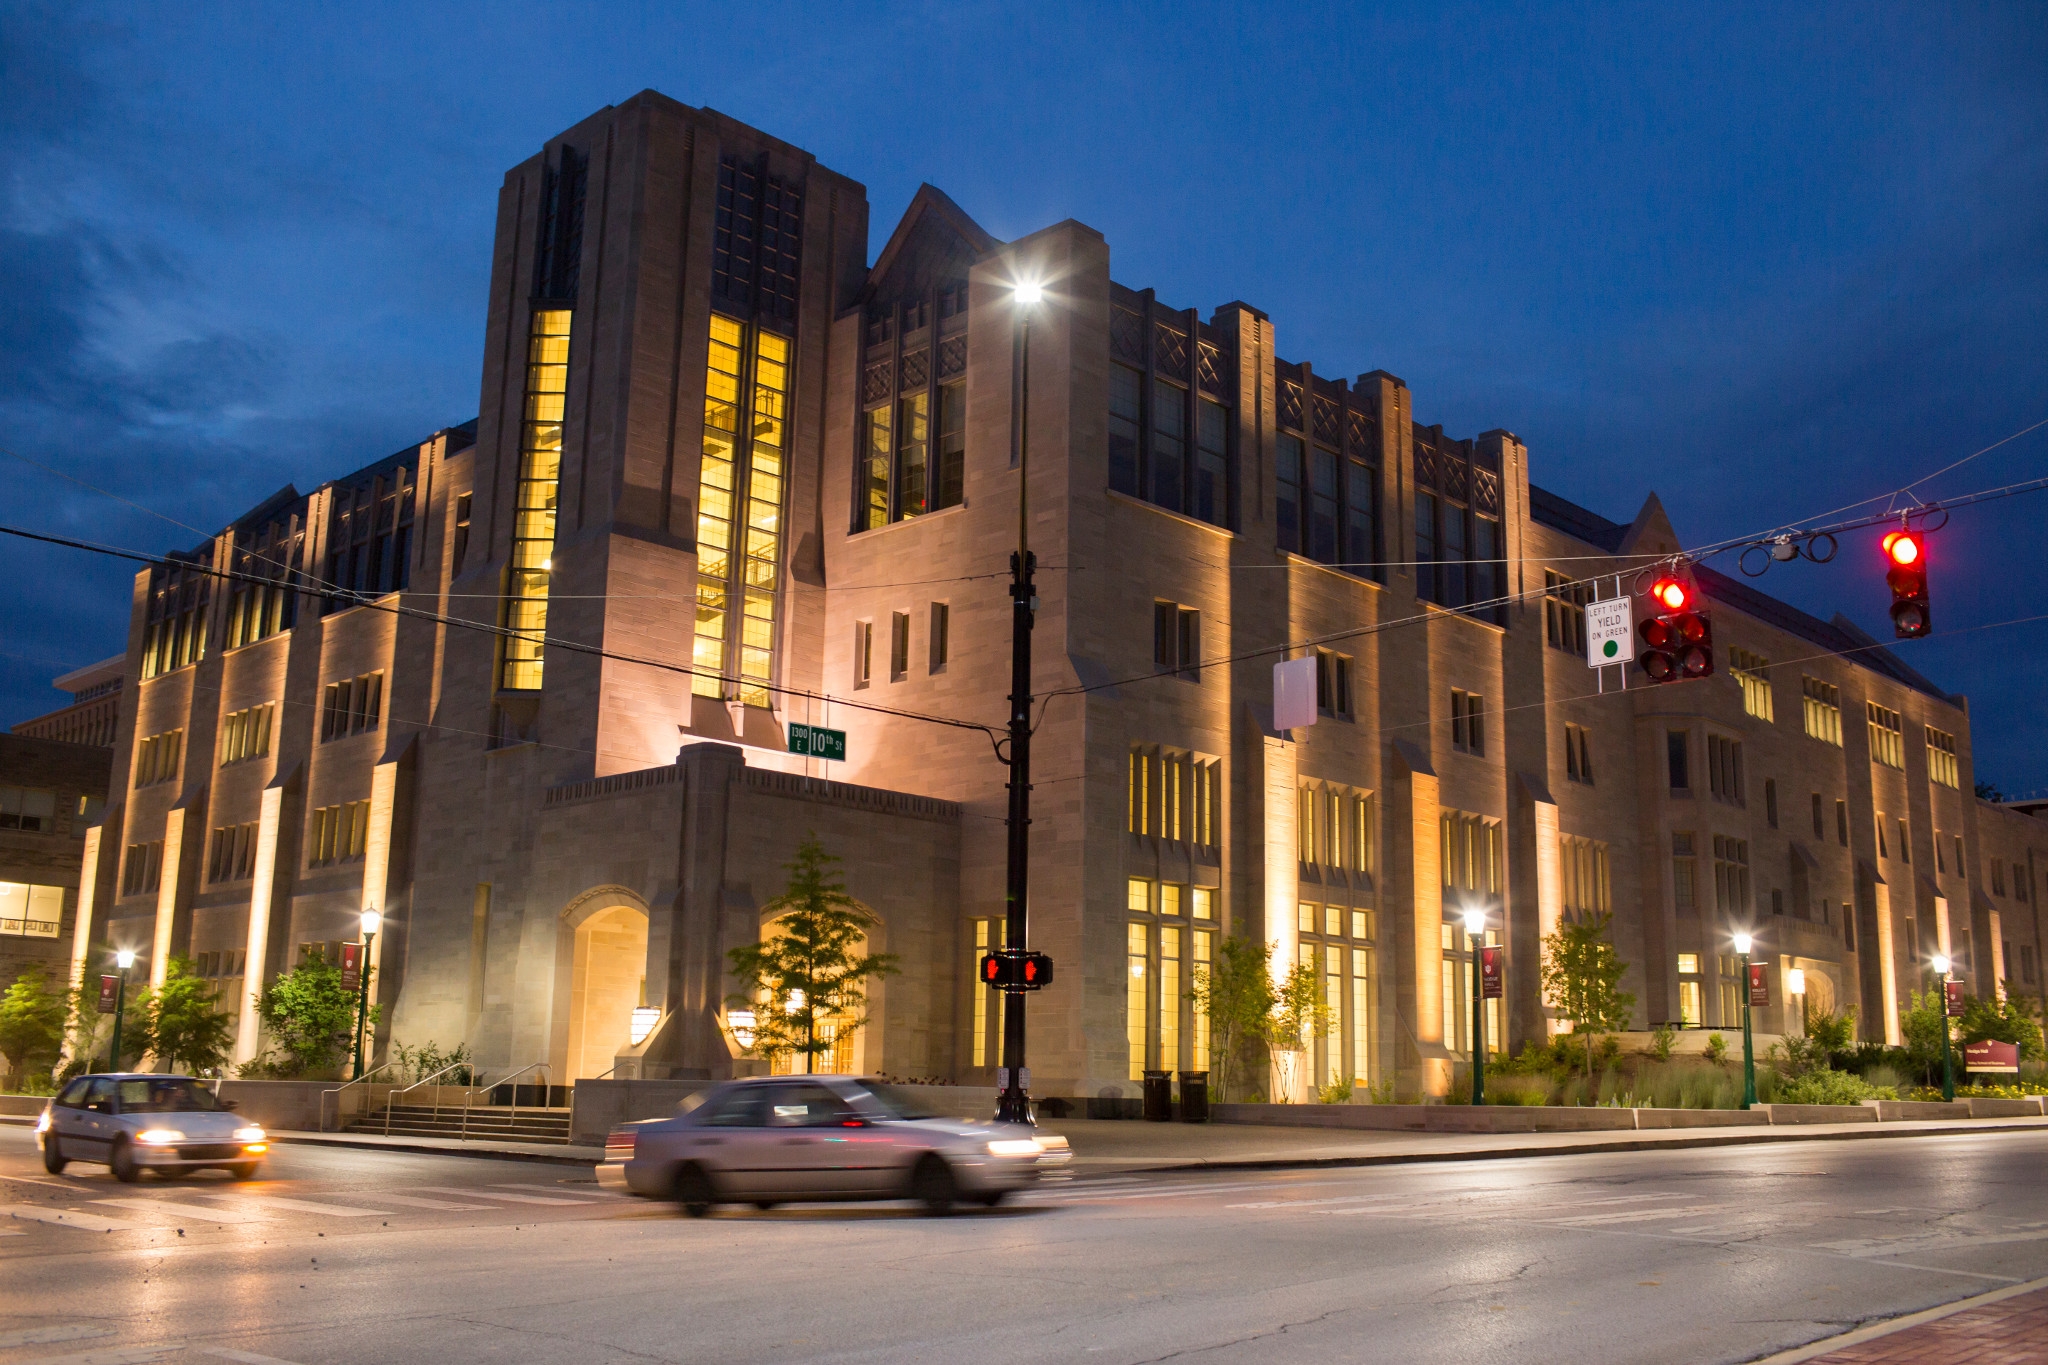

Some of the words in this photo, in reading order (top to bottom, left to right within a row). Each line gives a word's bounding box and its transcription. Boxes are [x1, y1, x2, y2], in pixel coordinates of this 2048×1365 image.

[1589, 606, 1606, 617] LEFT
[1609, 602, 1628, 613] TURN
[1598, 615, 1621, 628] YIELD
[1592, 632, 1602, 640] ON
[1605, 626, 1628, 638] GREEN
[791, 726, 808, 739] 1300
[812, 732, 834, 752] 10th
[835, 740, 842, 751] St
[796, 740, 801, 750] E
